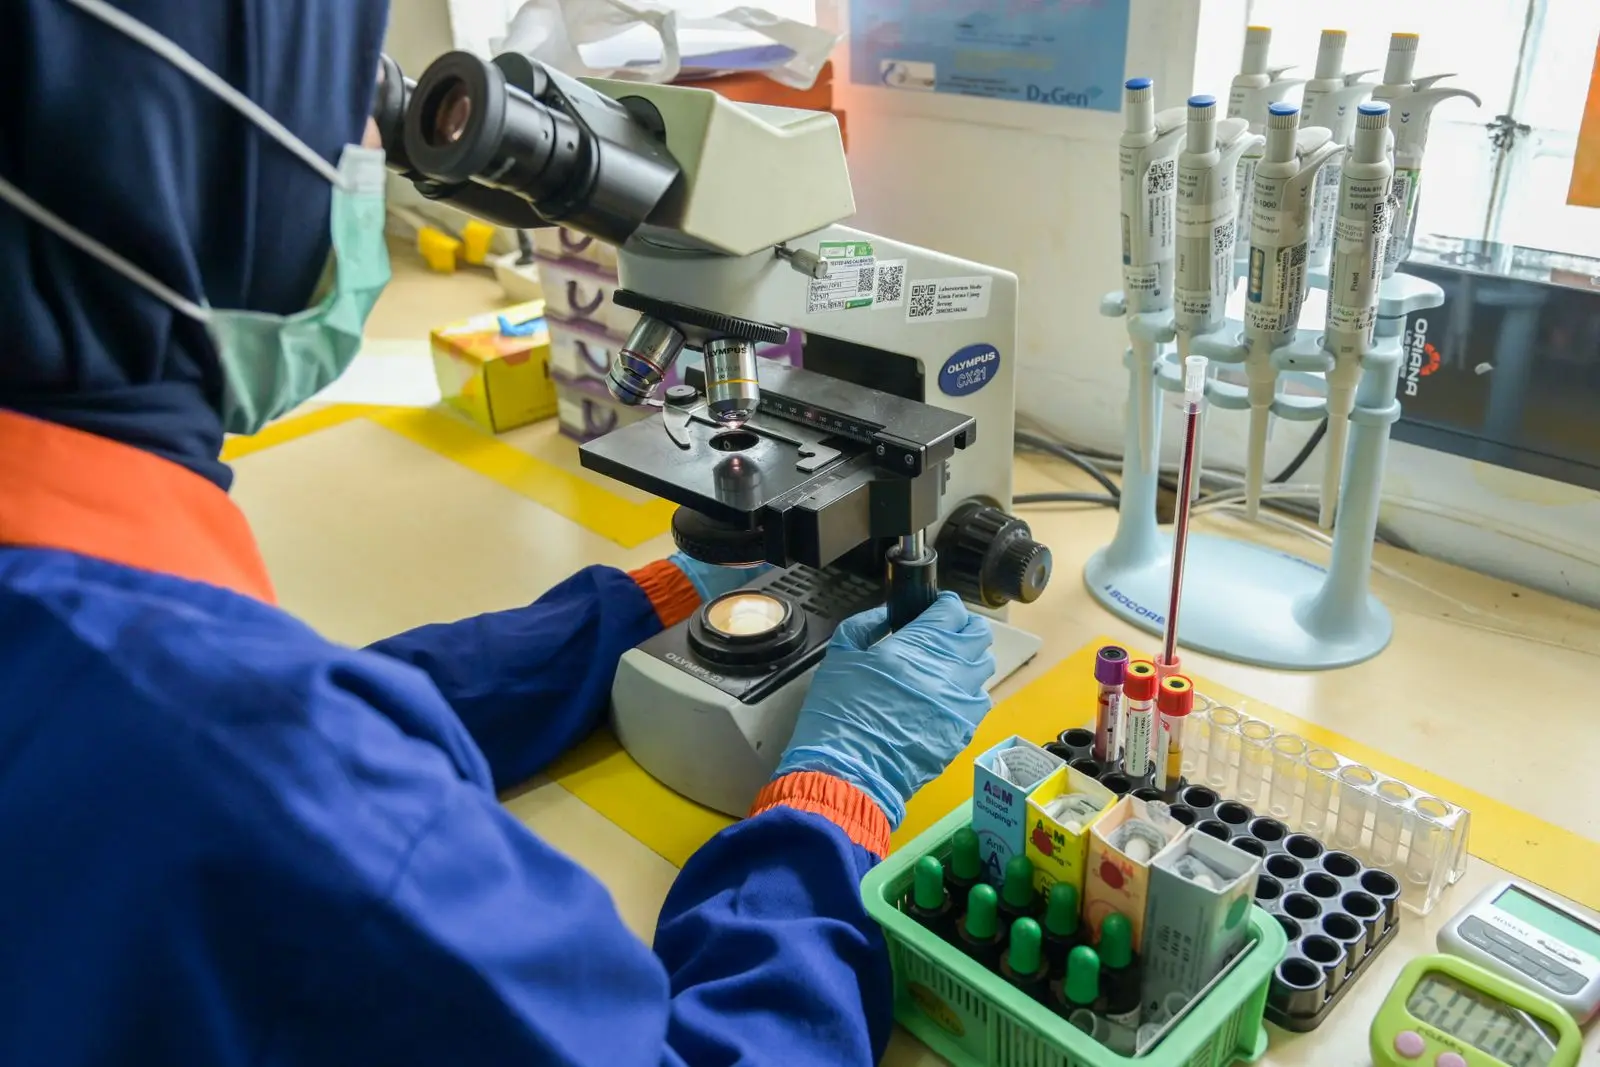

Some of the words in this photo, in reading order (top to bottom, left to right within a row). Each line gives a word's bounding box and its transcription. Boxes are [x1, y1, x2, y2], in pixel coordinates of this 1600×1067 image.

[1026, 83, 1089, 107] DxGen
[1350, 272, 1360, 292] Fixed
[947, 351, 996, 375] OLYMPUS
[1404, 318, 1428, 396] ORIANA
[956, 366, 987, 389] CX21
[665, 652, 723, 683] OLYMPUS
[985, 796, 1009, 814] Blood
[985, 837, 1005, 855] Anti
[987, 850, 1003, 877] A
[1425, 1029, 1457, 1049] CLEAR
